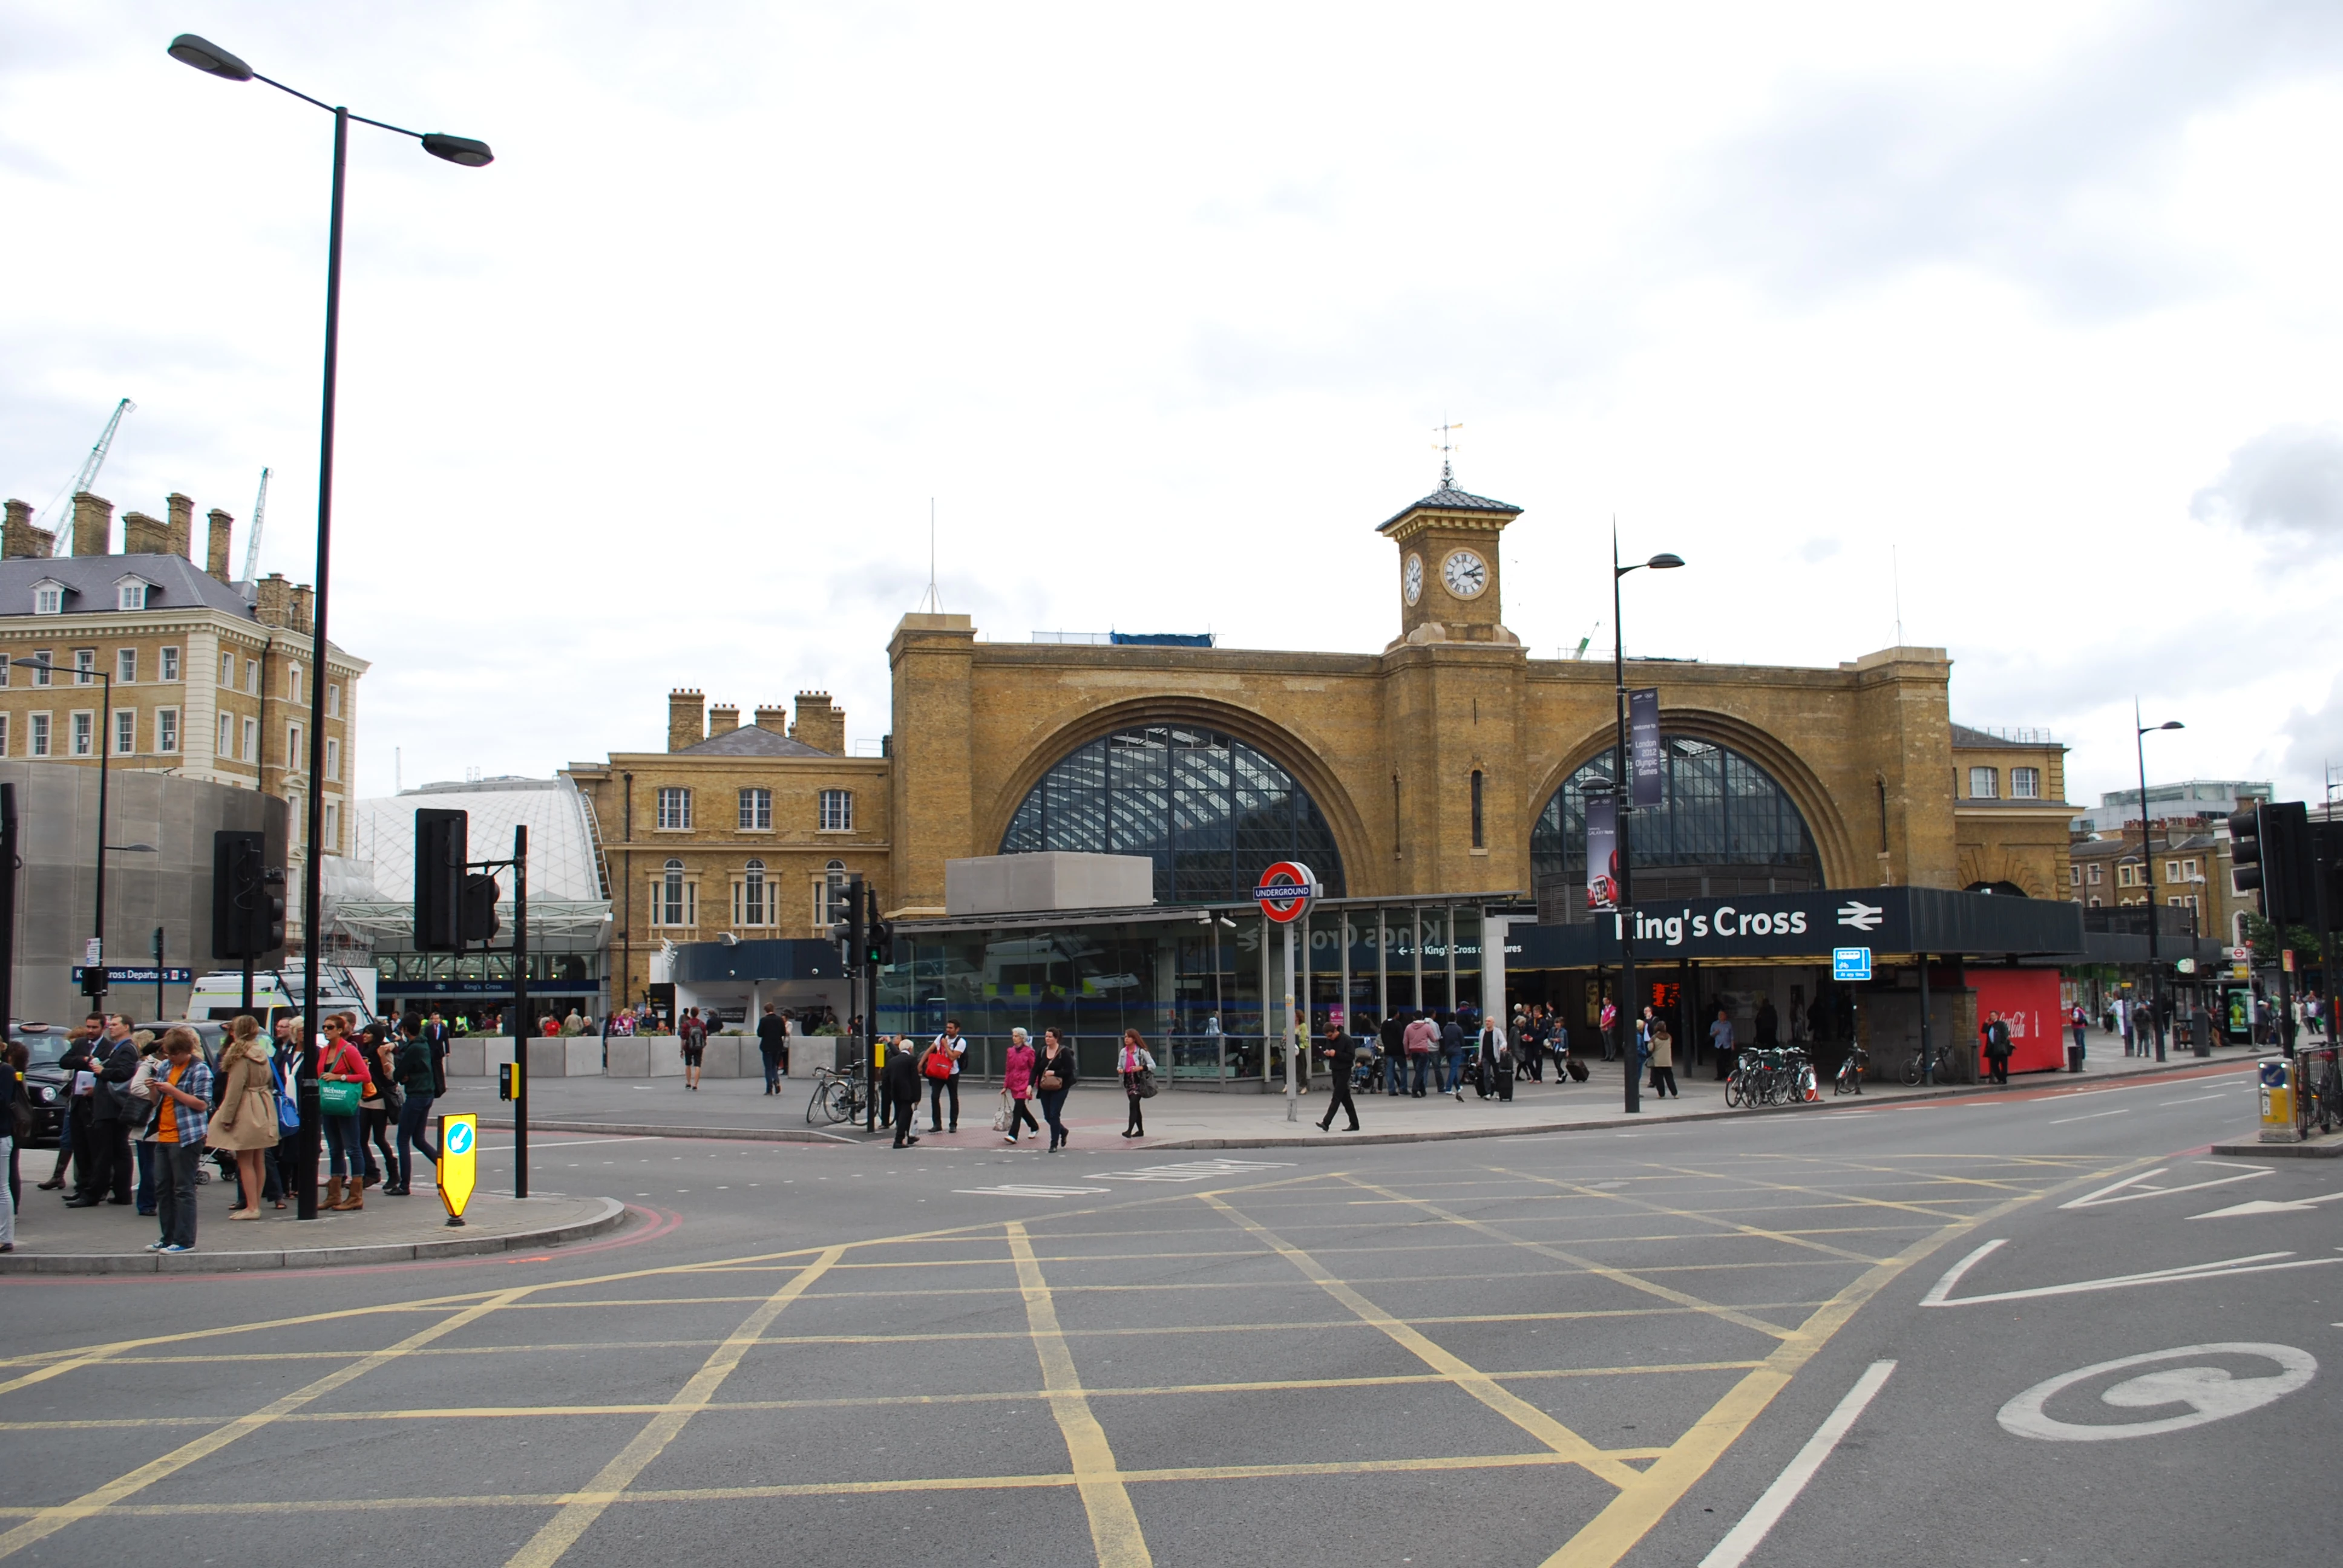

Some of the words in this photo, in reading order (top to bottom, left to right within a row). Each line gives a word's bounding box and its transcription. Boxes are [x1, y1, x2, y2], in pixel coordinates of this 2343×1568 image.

[1635, 740, 1657, 748] London
[1642, 748, 1657, 757] 2012
[1635, 758, 1657, 768] Olympic
[1256, 887, 1309, 897] UNDERGROUND
[1714, 906, 1807, 936] Cross
[1453, 945, 1476, 954] Cross
[107, 970, 126, 979] ross
[127, 969, 168, 981] Departues
[1081, 1158, 1299, 1182] ENTRY
